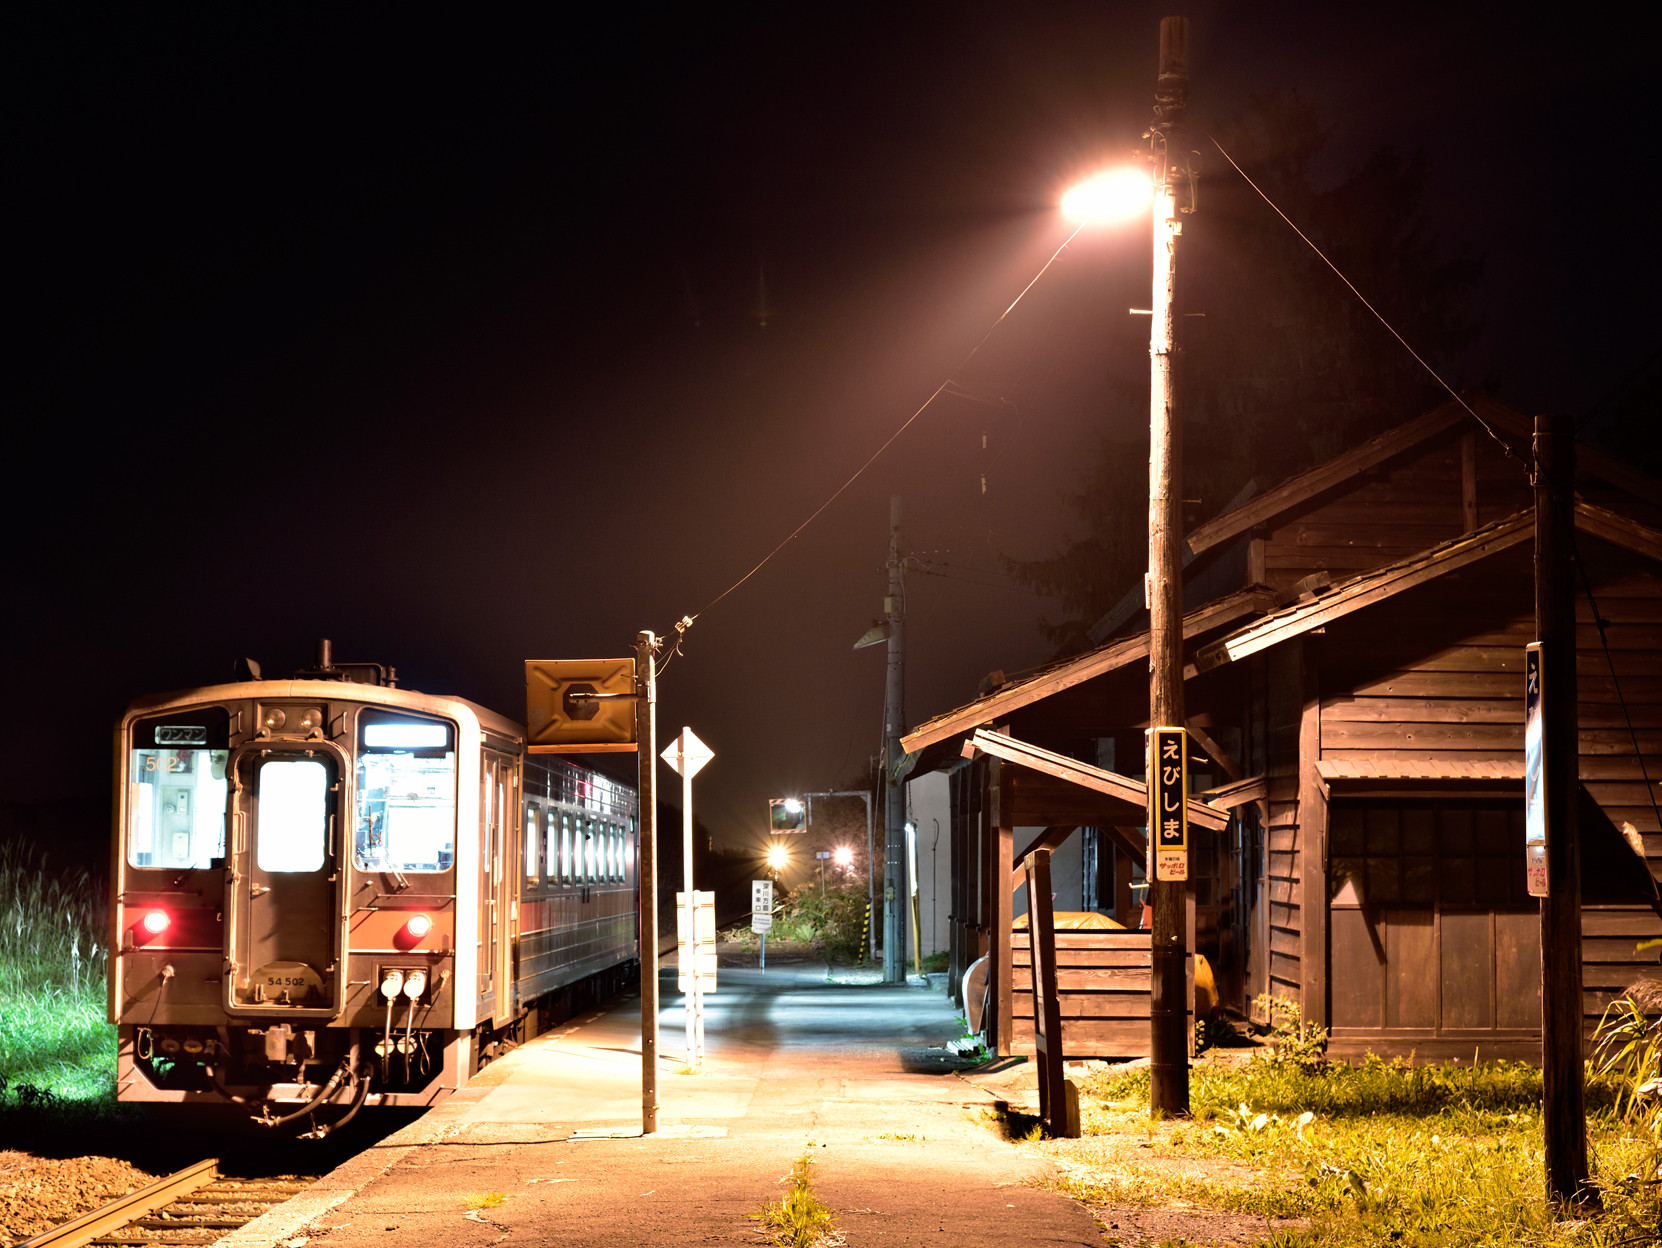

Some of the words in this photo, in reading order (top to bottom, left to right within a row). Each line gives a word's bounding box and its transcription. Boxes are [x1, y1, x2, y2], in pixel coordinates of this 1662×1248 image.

[161, 729, 205, 740] ワンマン
[146, 756, 177, 772] 502
[1162, 739, 1181, 839] えびしま
[268, 977, 282, 986] 54
[285, 977, 304, 986] 502
